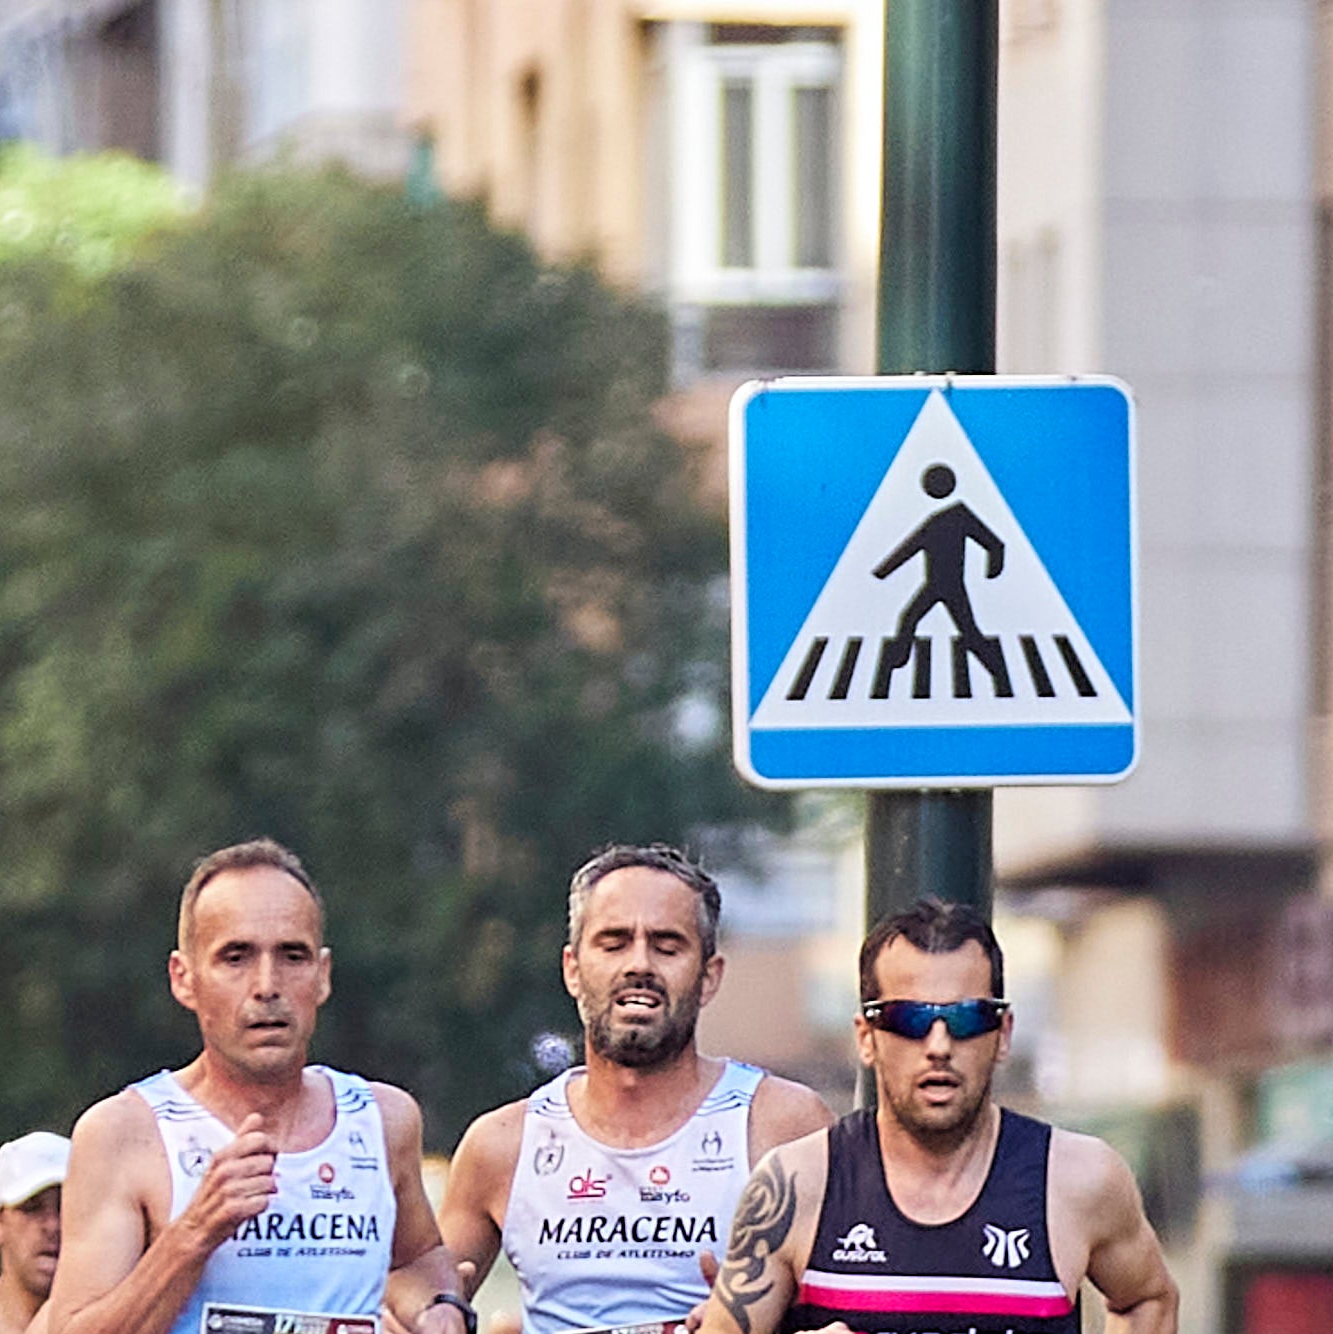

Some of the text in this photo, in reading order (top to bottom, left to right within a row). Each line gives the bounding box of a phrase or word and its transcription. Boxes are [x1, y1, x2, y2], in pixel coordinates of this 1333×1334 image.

[539, 1215, 718, 1245] MARACENA
[558, 1249, 695, 1261] CLUB DE ATLETISMO
